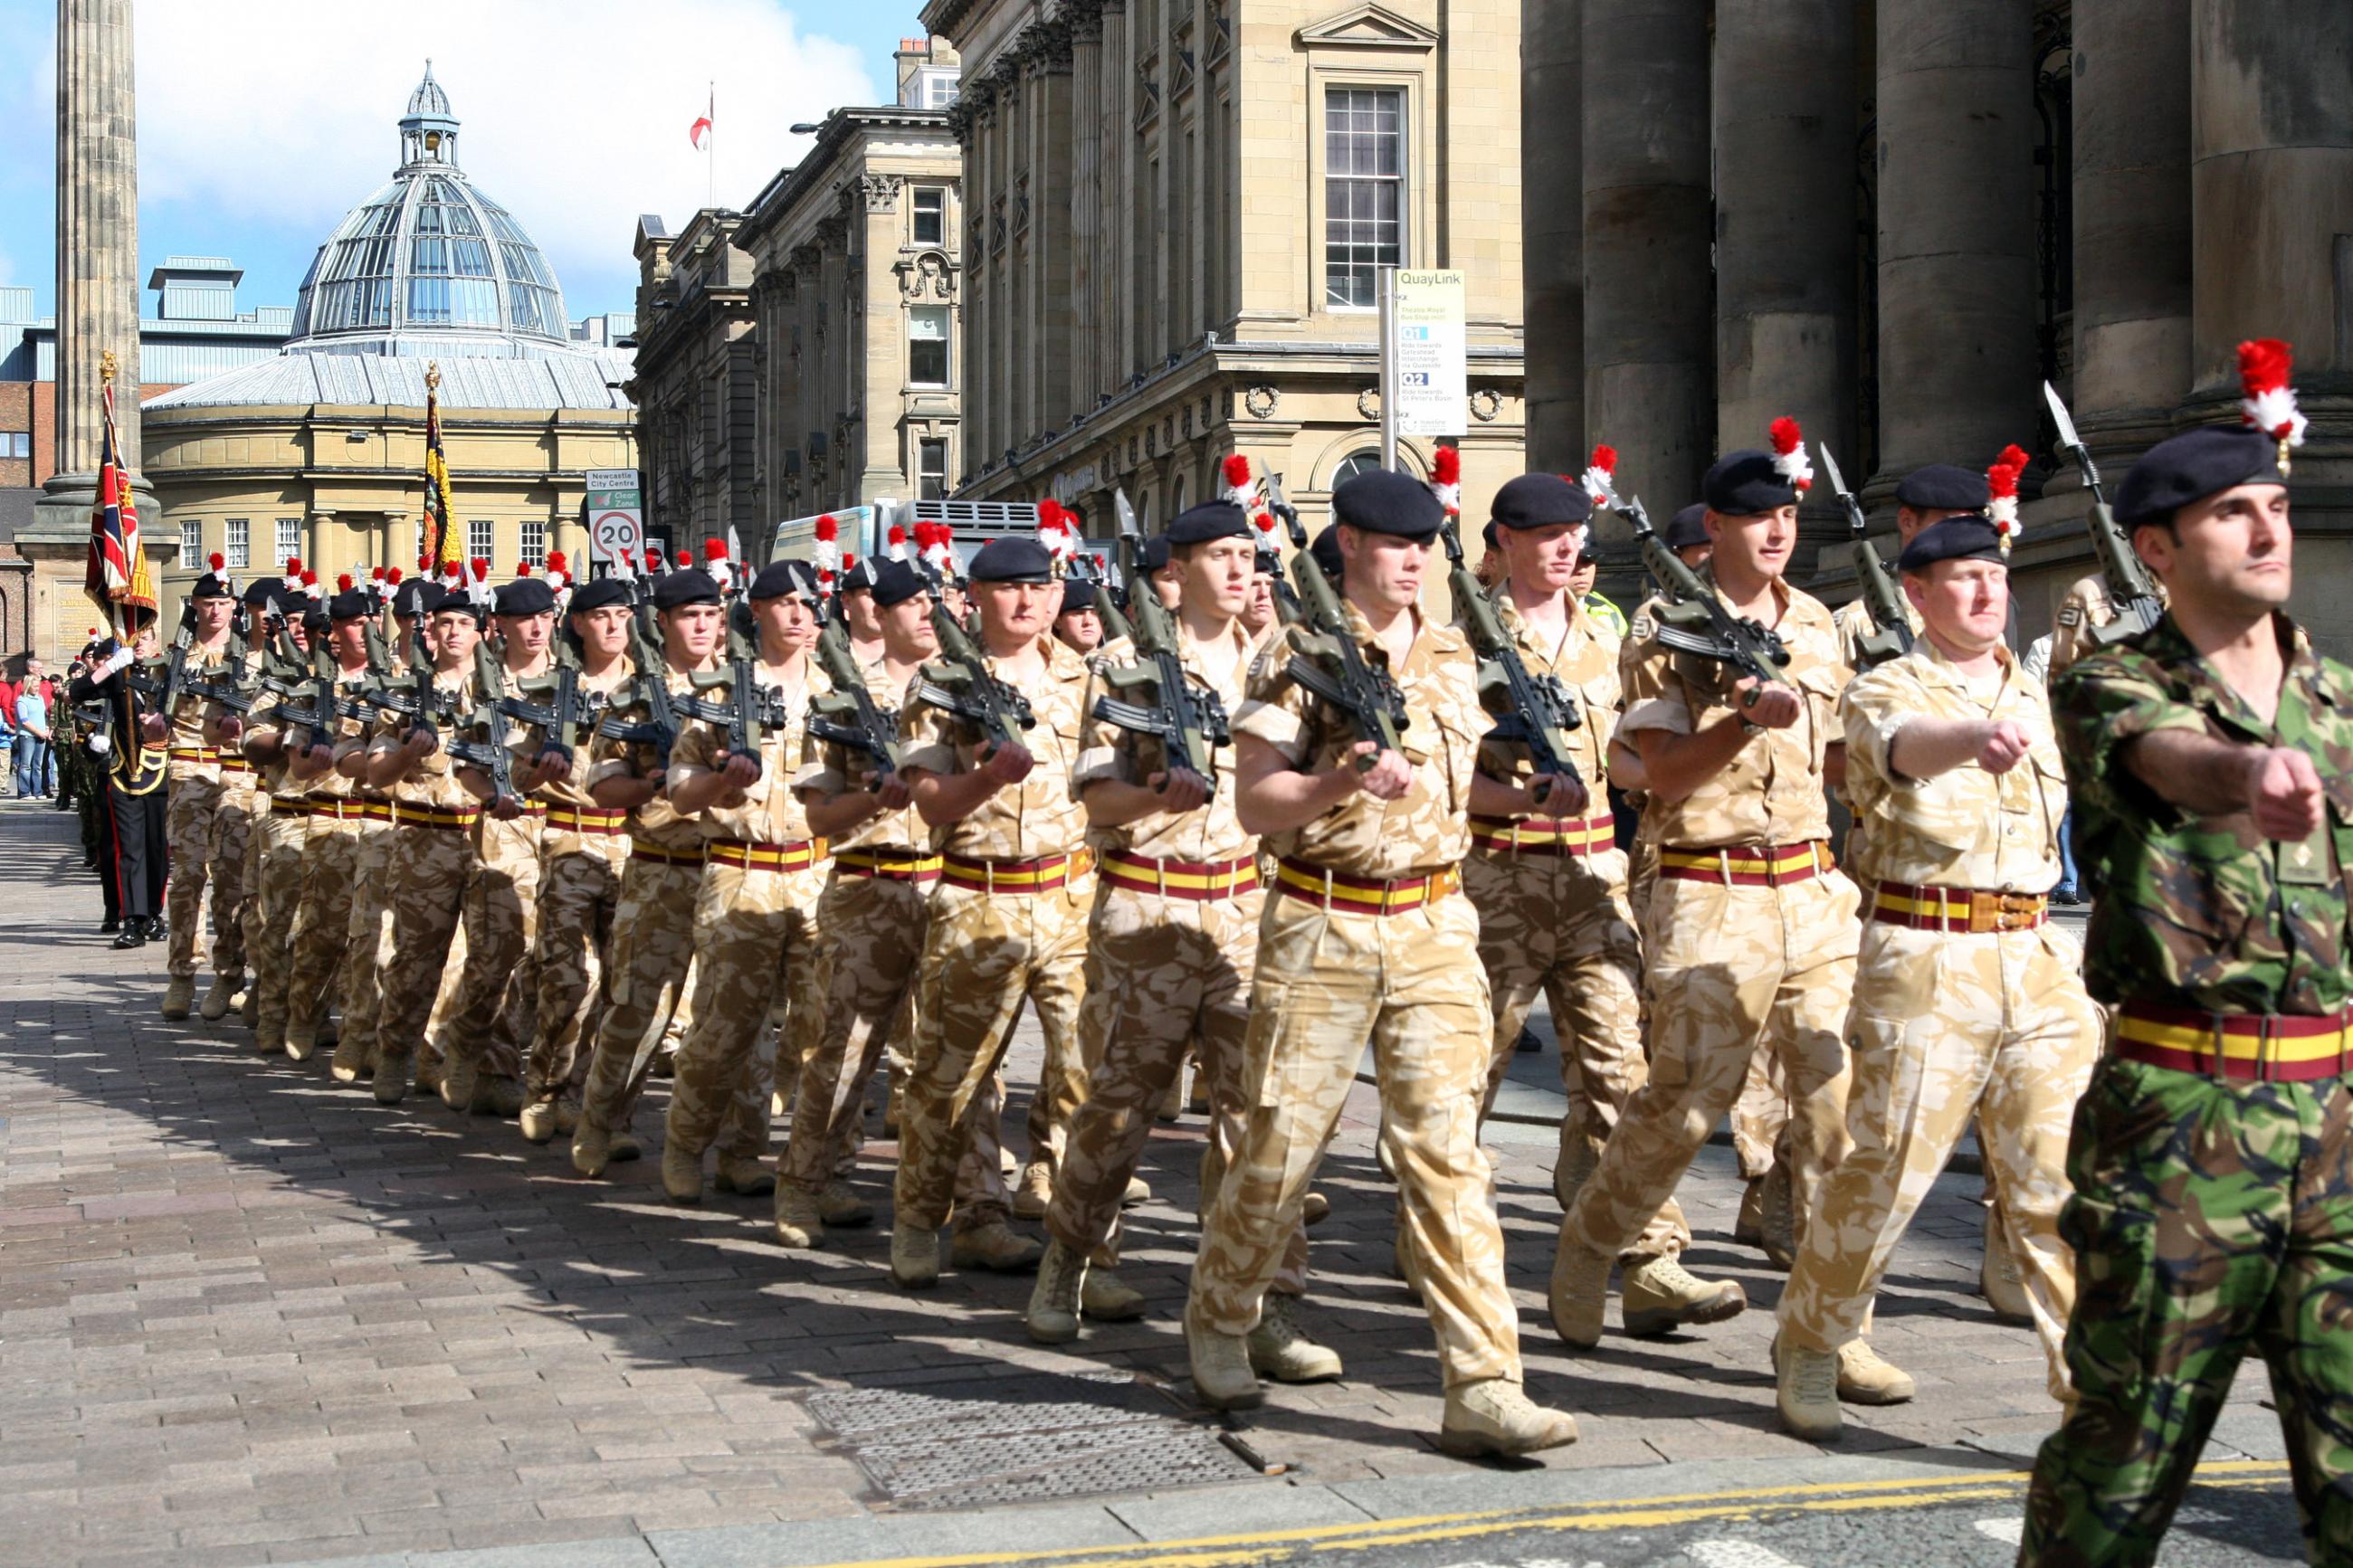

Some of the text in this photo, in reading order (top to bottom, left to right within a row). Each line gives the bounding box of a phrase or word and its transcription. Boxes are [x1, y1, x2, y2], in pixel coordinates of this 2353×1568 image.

[1401, 272, 1461, 287] QuayLink
[1403, 327, 1420, 339] Q1
[1403, 373, 1424, 385] Q2
[614, 491, 636, 499] Clear
[614, 499, 635, 508] Zone
[601, 525, 634, 544] 20
